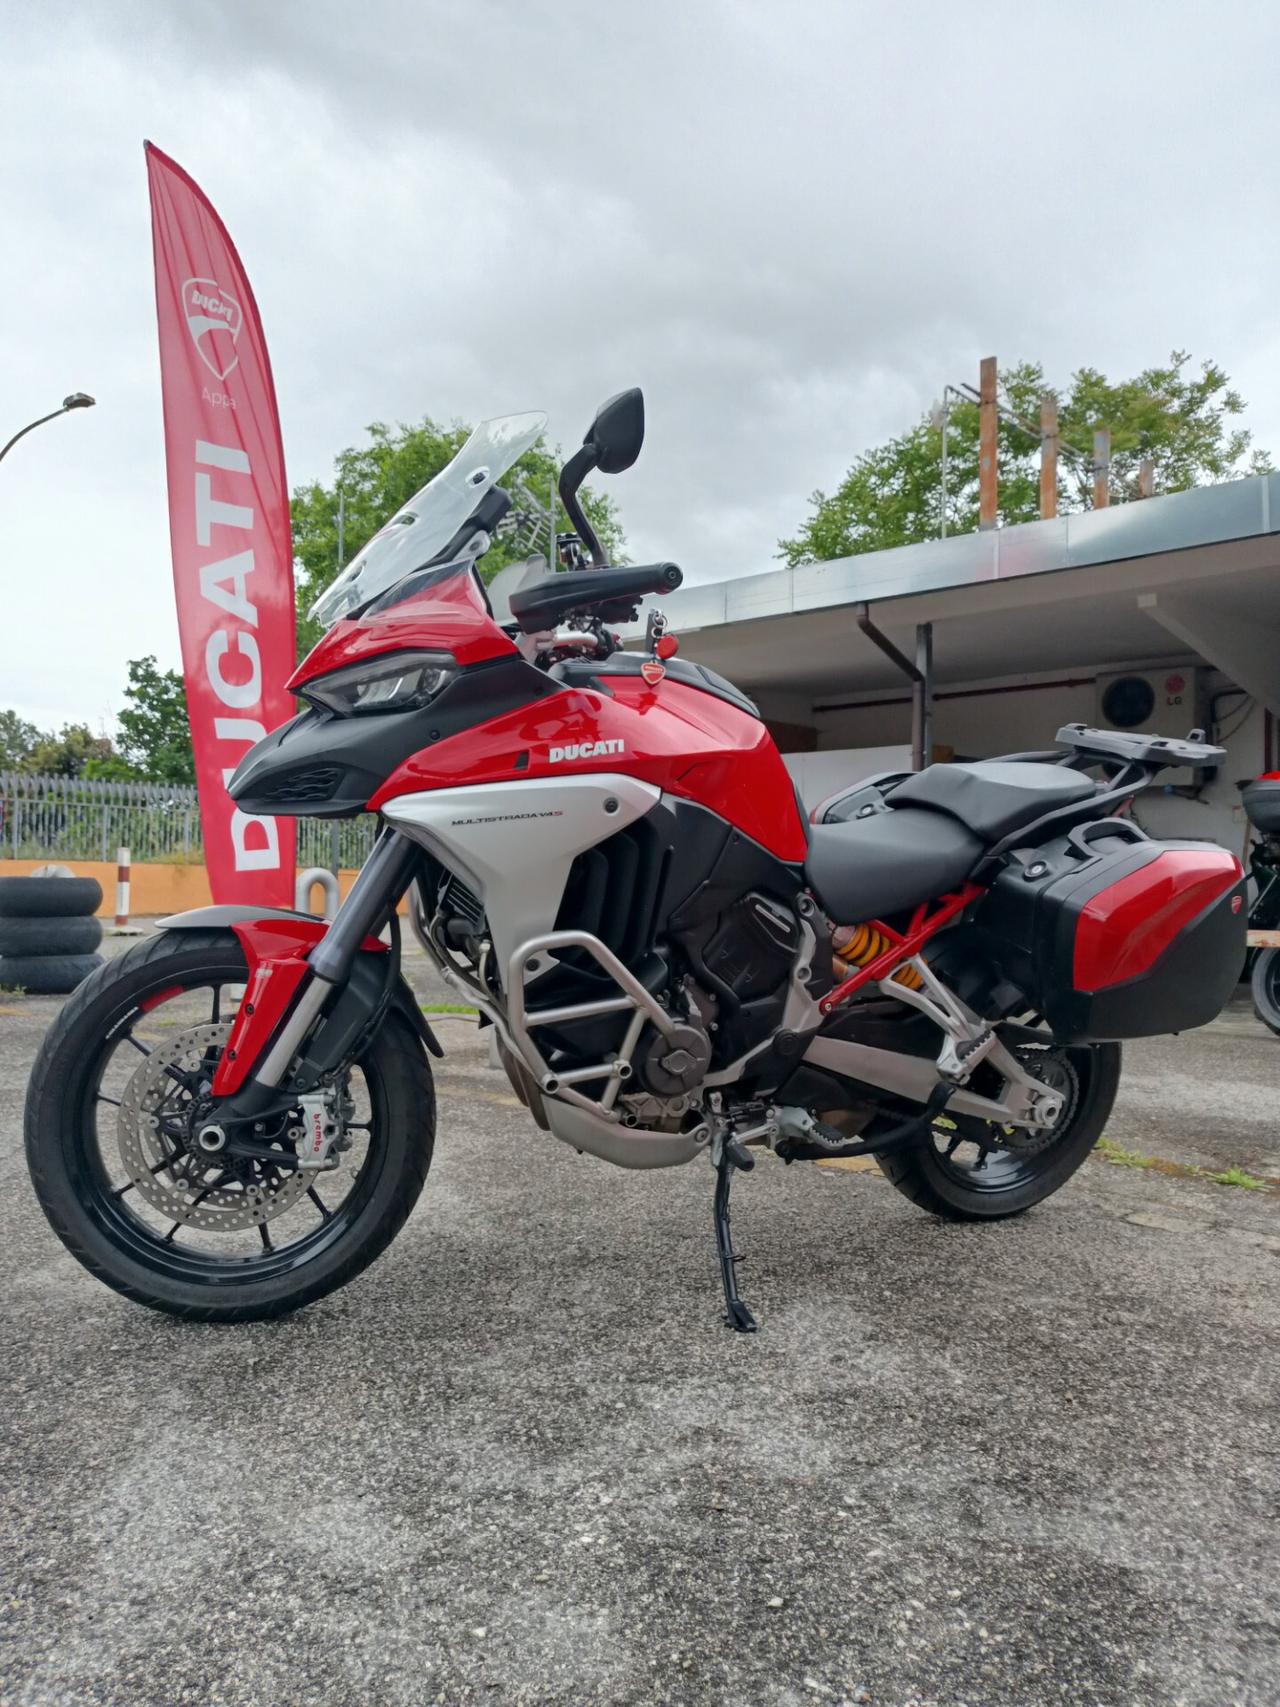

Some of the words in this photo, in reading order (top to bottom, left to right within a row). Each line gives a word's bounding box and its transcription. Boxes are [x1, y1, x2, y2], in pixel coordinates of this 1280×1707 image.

[1166, 695, 1183, 706] LG
[549, 739, 625, 763] DUCATI
[313, 1113, 323, 1152] brembo
